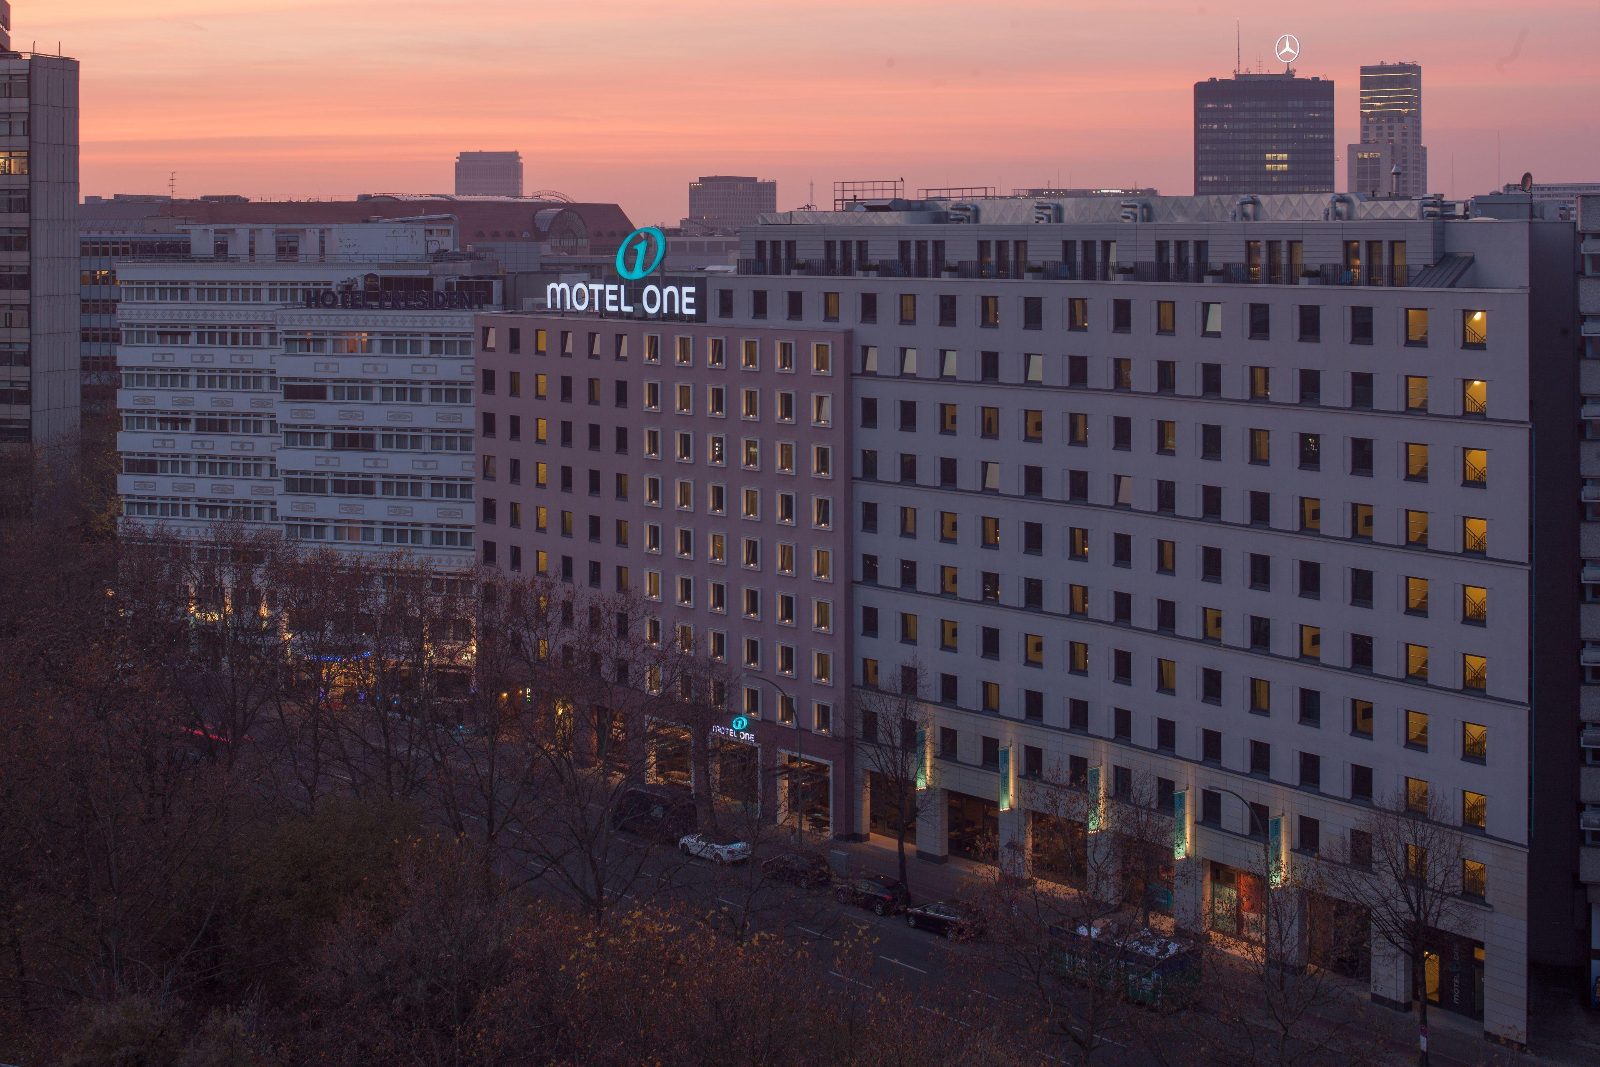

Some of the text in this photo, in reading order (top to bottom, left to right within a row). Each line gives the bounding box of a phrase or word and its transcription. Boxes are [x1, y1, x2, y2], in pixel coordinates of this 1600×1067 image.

[306, 289, 375, 309] HOTEL
[546, 282, 697, 315] MOTEL ONE
[739, 731, 755, 743] ONE
